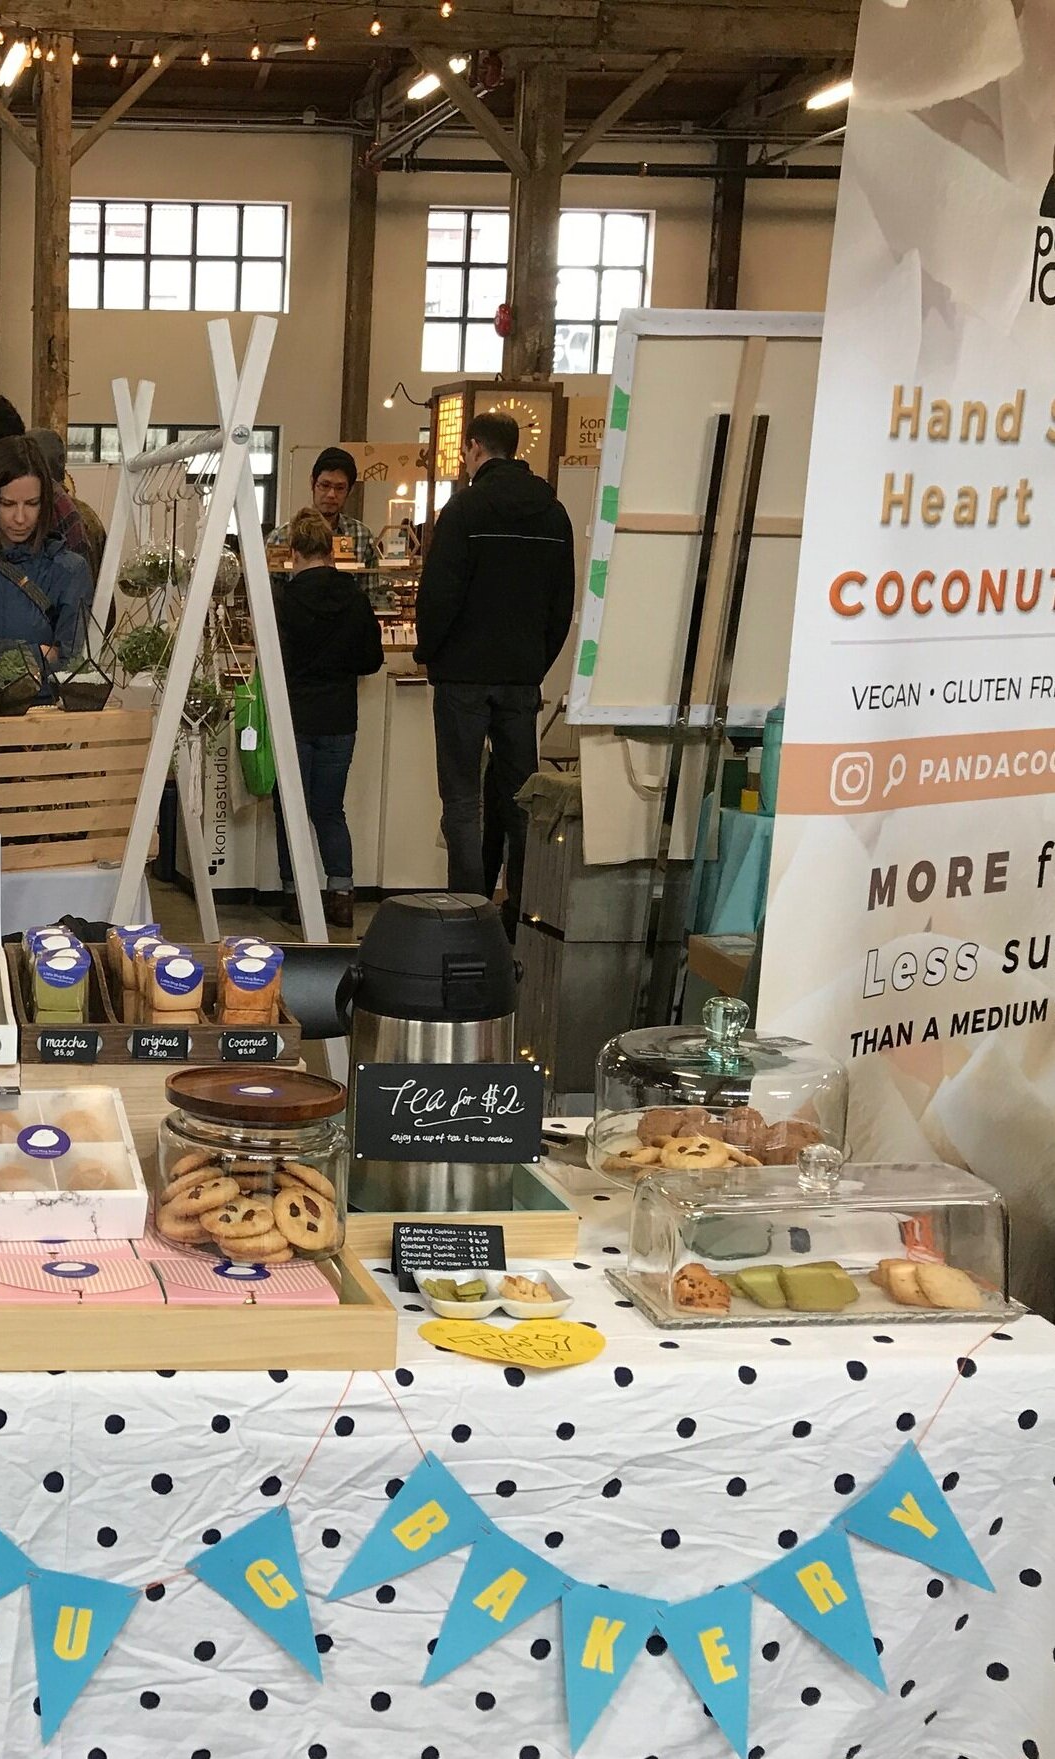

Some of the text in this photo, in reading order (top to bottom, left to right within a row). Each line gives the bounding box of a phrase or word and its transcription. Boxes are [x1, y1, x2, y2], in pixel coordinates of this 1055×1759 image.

[580, 416, 606, 429] kon
[889, 384, 1026, 443] Hand
[579, 431, 604, 443] stu
[880, 472, 1033, 527] Heart
[852, 675, 1055, 711] VEGAN GLUTEN FR
[212, 746, 228, 855] konisastudio
[867, 850, 1011, 911] MORE
[862, 935, 1052, 999] Less su
[228, 1037, 268, 1048] Coconut
[850, 998, 1049, 1058] THAN A MEDIUM
[450, 1087, 477, 1117] for
[390, 1133, 412, 1144] enjoy
[422, 1135, 435, 1143] cup
[435, 1133, 445, 1143] of
[447, 1134, 461, 1142] tea
[487, 1136, 514, 1144] cookies
[447, 1333, 572, 1352] TRY
